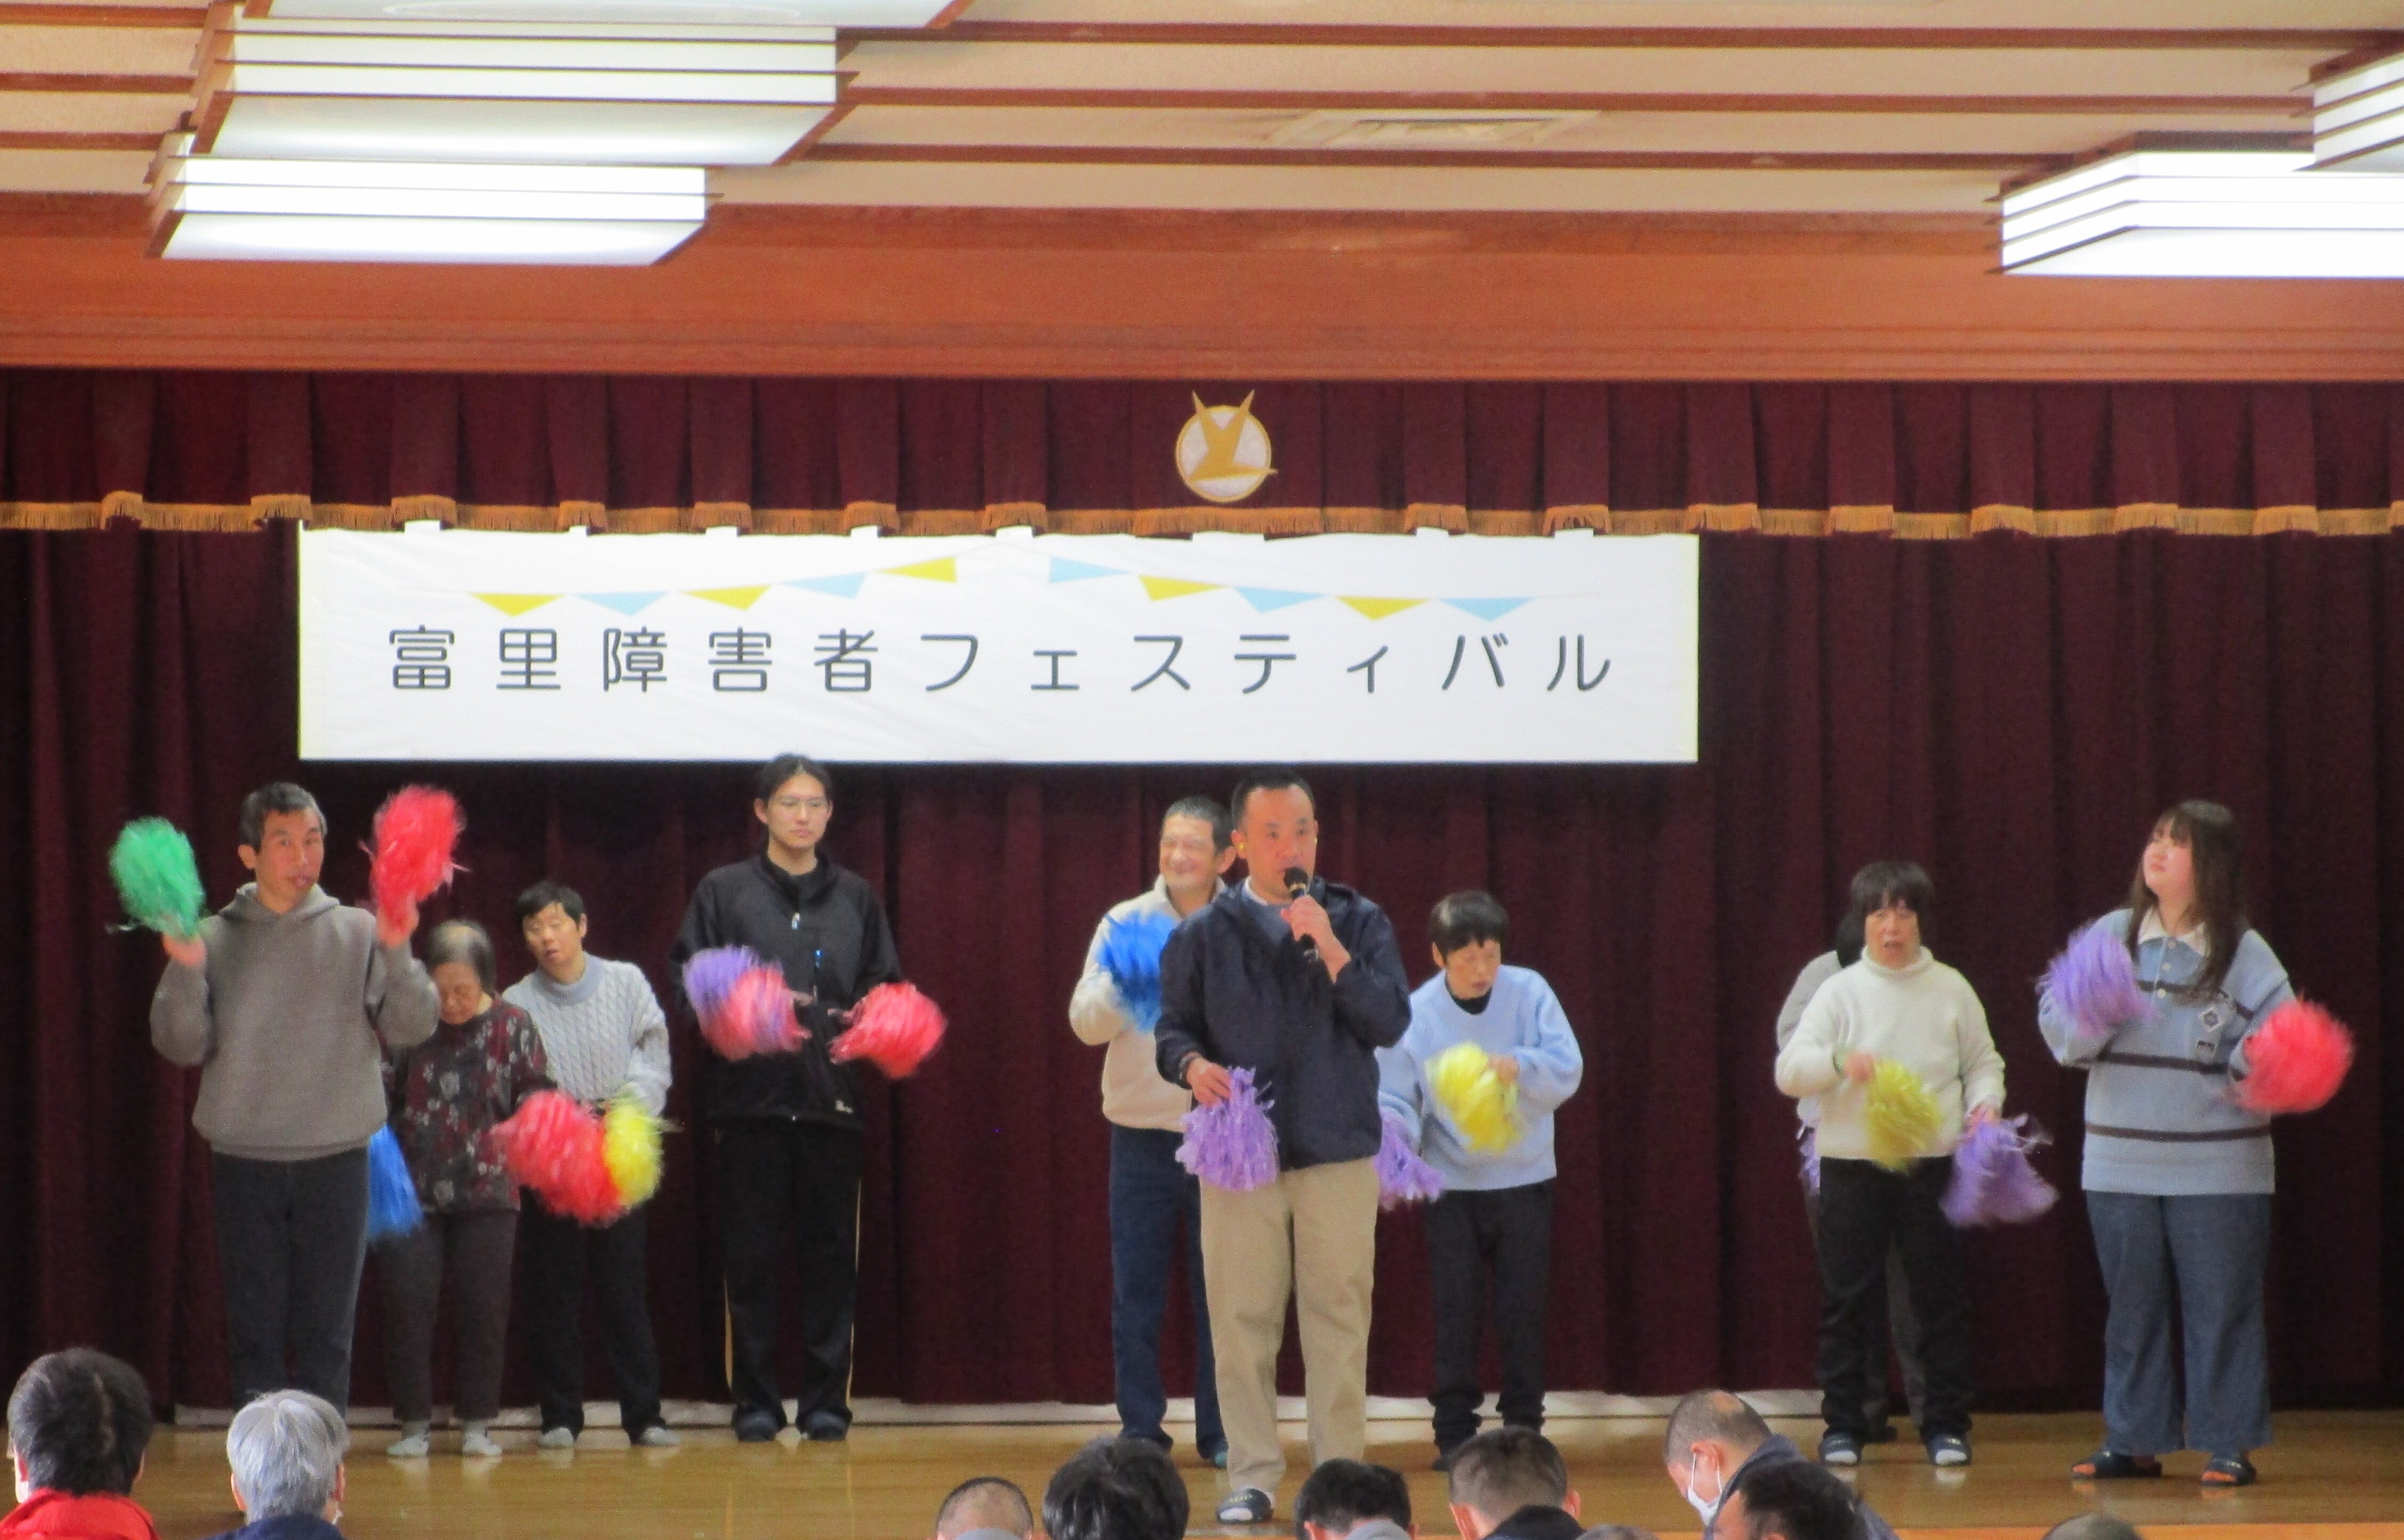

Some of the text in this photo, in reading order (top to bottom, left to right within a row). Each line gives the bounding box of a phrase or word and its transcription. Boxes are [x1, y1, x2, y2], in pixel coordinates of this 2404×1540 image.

[388, 625, 1611, 693] 富里障害者フェスティバル
